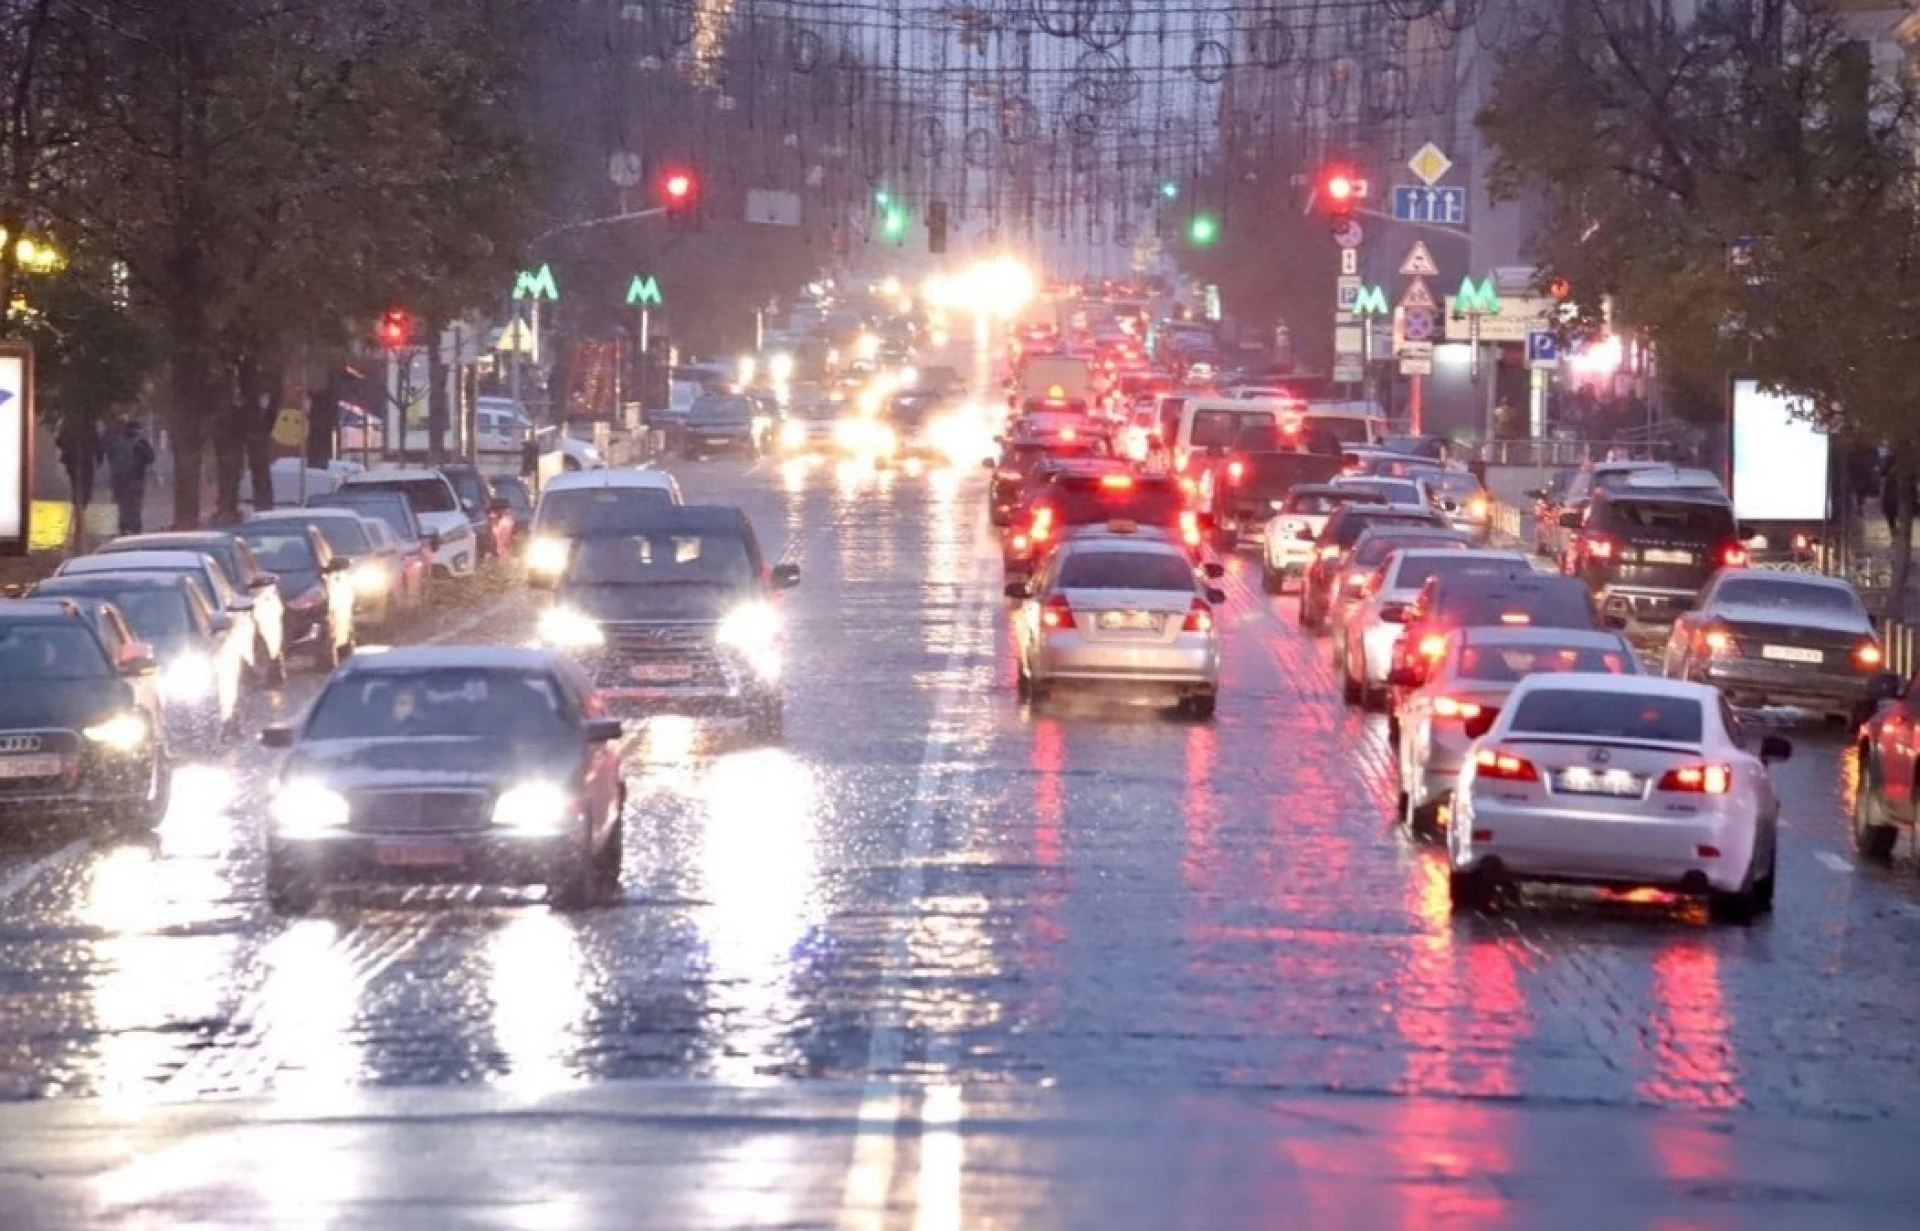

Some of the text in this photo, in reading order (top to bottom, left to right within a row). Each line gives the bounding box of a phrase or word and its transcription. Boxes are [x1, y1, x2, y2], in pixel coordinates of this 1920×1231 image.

[512, 262, 559, 300] M
[625, 275, 662, 304] M
[1454, 276, 1498, 314] M
[1352, 285, 1389, 314] M
[1534, 335, 1552, 358] P
